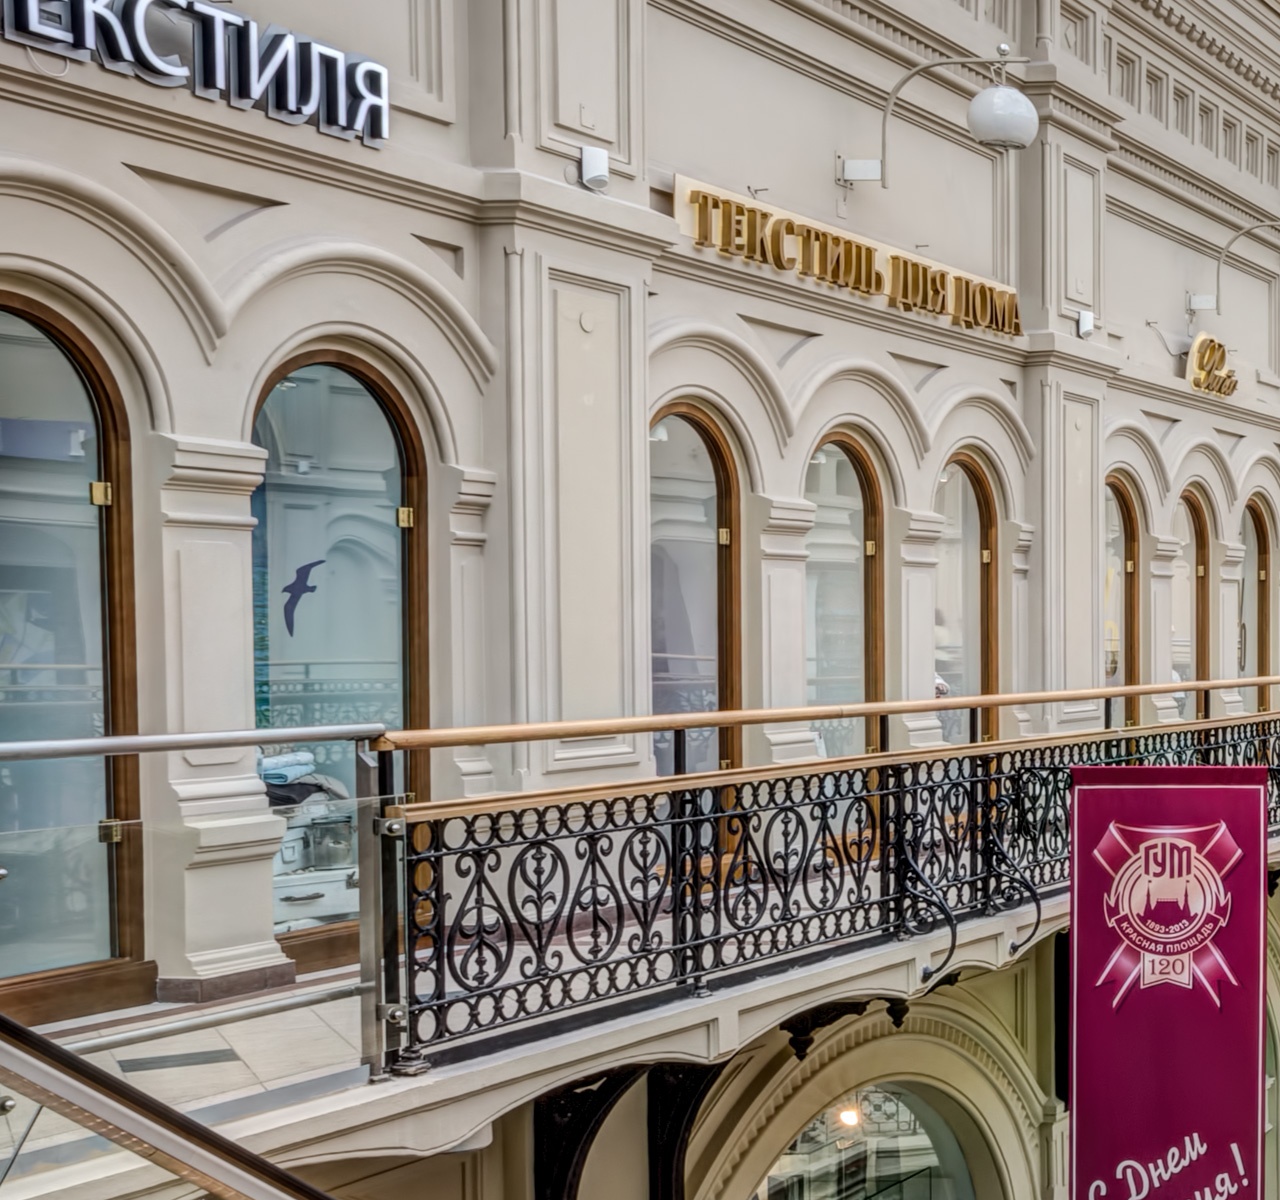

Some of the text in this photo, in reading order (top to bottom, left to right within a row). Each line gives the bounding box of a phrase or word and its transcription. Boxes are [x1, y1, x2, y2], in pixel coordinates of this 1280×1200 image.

[690, 189, 1024, 336] ТЕКСТИЛЬ ДЛЯ ДОМА
[1144, 841, 1192, 879] ГУМ
[1120, 921, 1214, 953] КРАСНАЯ ПЛОЩАДЬ
[1148, 958, 1186, 977] 120
